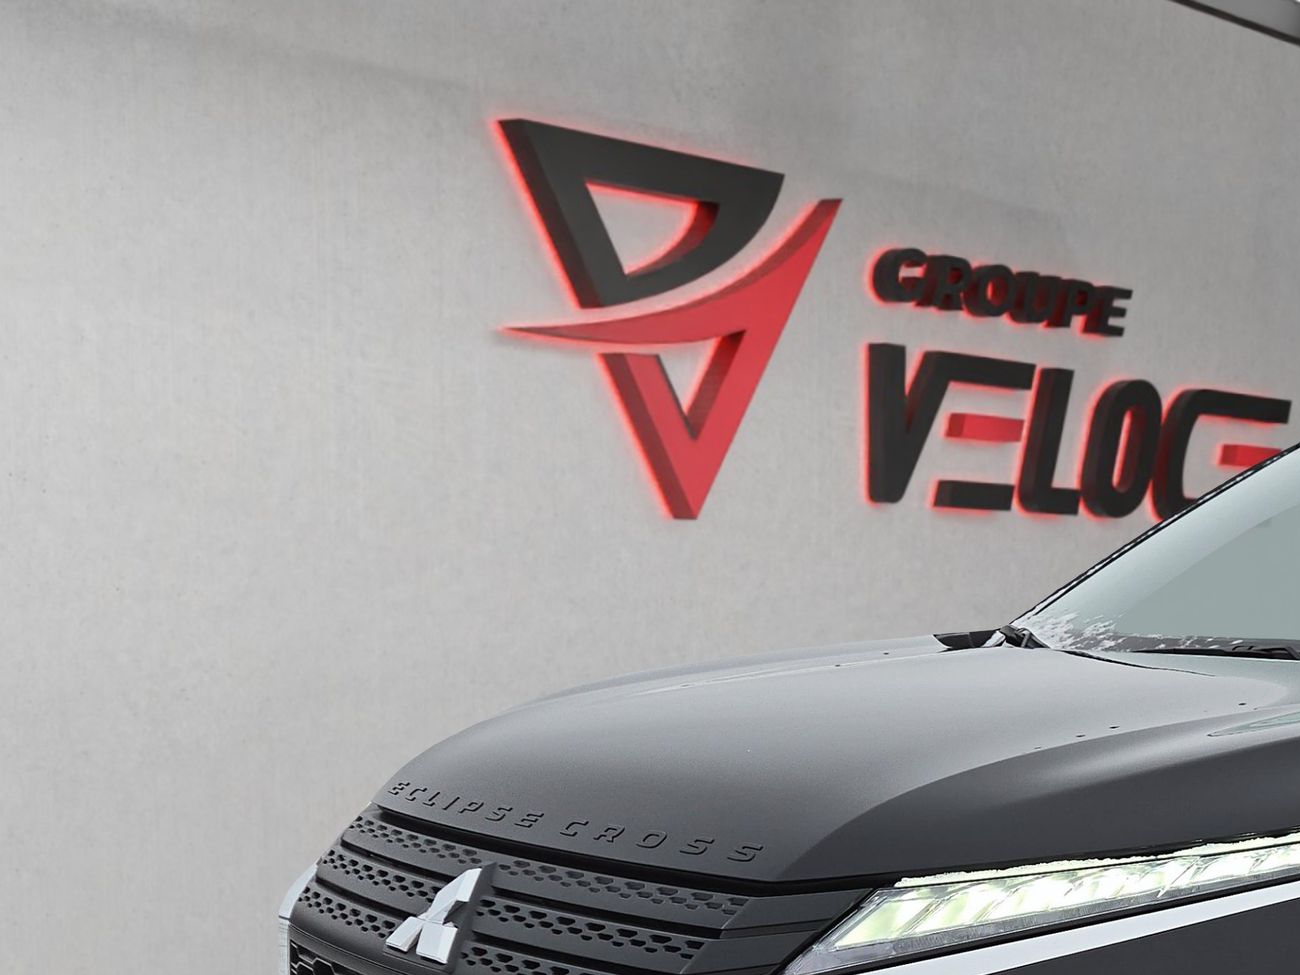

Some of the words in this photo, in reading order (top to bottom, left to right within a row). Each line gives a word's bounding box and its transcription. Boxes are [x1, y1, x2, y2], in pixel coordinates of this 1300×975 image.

[870, 247, 1133, 337] GROUPE
[387, 781, 545, 828] ECLIPSE
[559, 820, 764, 862] CROSS
